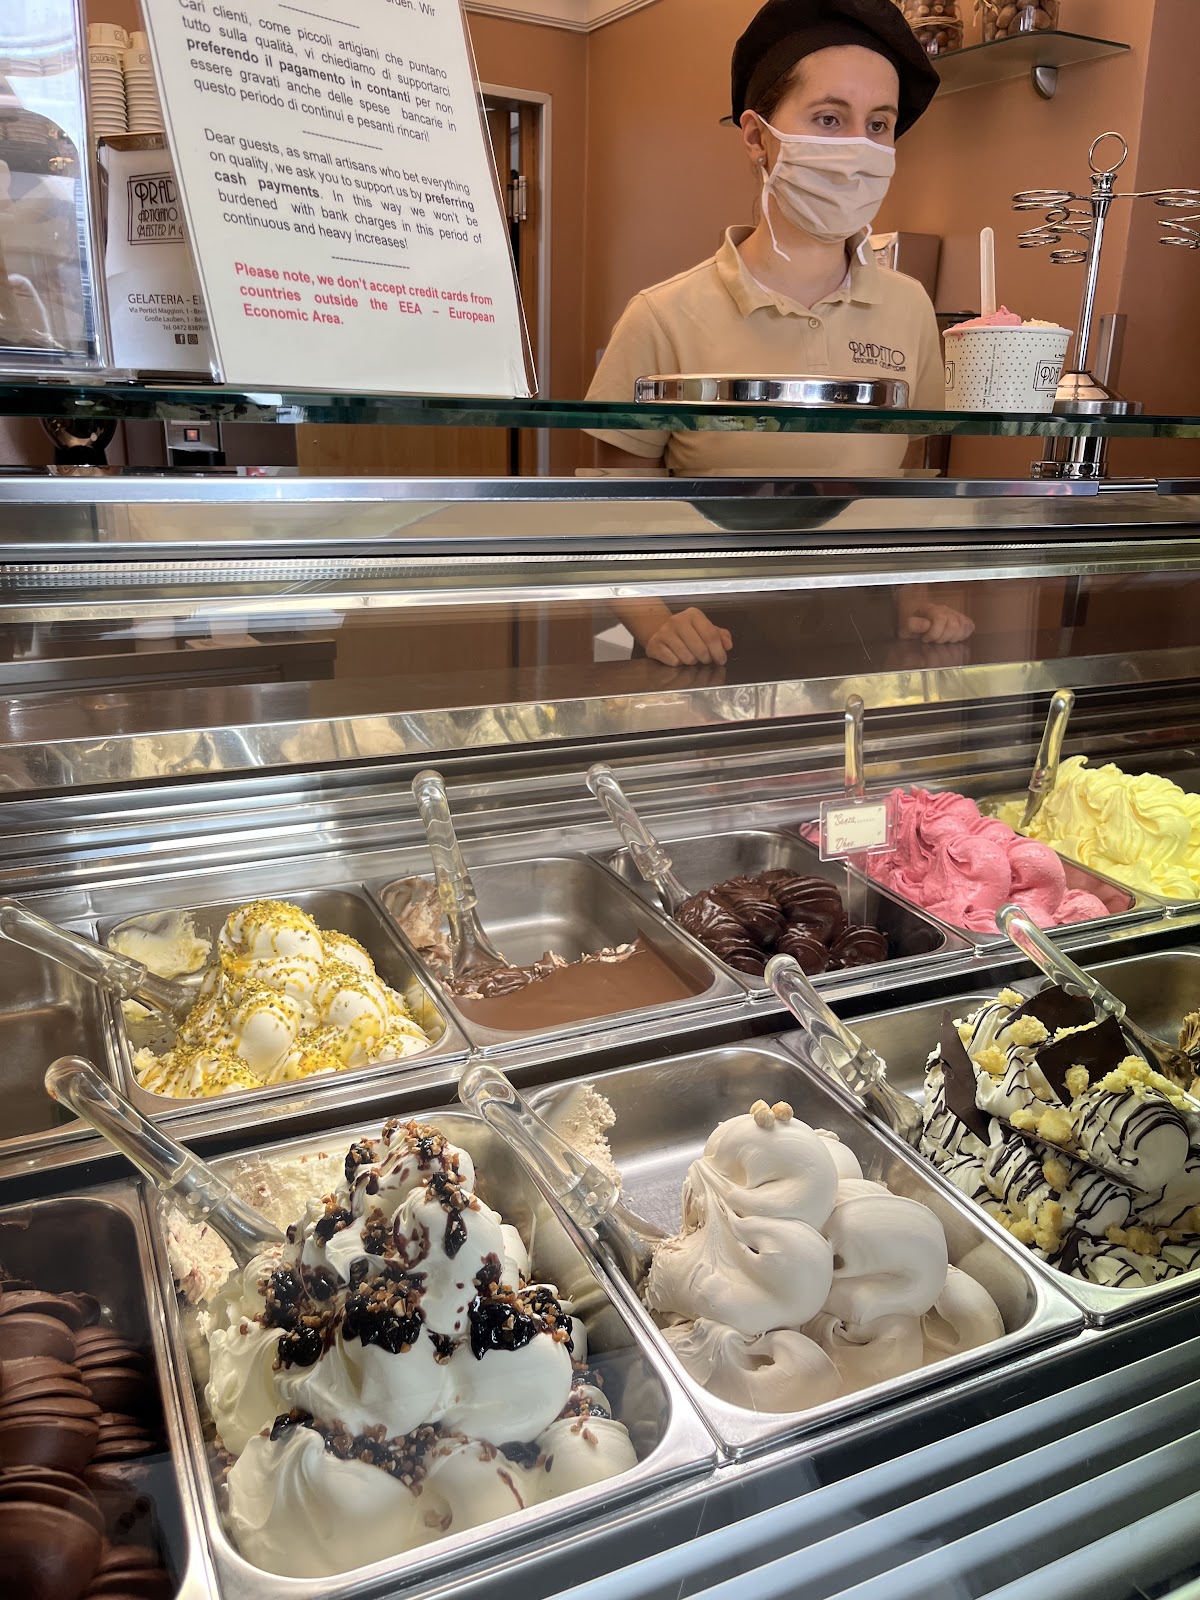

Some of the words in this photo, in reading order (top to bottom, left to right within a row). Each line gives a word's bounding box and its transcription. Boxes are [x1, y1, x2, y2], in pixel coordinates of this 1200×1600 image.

[418, 2, 436, 17] Wir
[179, 0, 206, 13] Cari
[213, 5, 252, 27] clienti,
[259, 19, 291, 35] come
[297, 28, 333, 46] piccoli
[338, 40, 380, 60] artigiani
[385, 52, 404, 66] che
[409, 60, 448, 79] puntano
[182, 16, 211, 33] tutto
[219, 26, 247, 42] sulla
[255, 36, 298, 57] qualità,
[304, 48, 315, 60] vi
[321, 52, 376, 76] chiediamo
[382, 68, 392, 80] di
[397, 73, 451, 97] supportarci
[187, 38, 259, 63] preferendo
[264, 54, 273, 67] il
[279, 60, 346, 85] pagamento
[351, 75, 362, 90] in
[367, 82, 411, 103] contanti
[415, 96, 431, 109] per
[435, 101, 454, 115] non
[190, 58, 233, 77] essere
[240, 70, 280, 89] gravati
[286, 80, 322, 98] anche
[327, 90, 354, 106] delle
[359, 99, 391, 115] spese
[401, 108, 443, 129] bancarie
[448, 119, 457, 132] in
[193, 79, 236, 97] questo
[239, 89, 285, 108] periodo
[287, 99, 298, 111] di
[301, 103, 345, 122] continui
[347, 113, 355, 124] e
[357, 116, 395, 134] pesanti
[397, 125, 430, 142] rincari!
[204, 127, 236, 145] Dear
[239, 137, 283, 157] guests,
[286, 147, 301, 158] as
[303, 150, 333, 165] small
[335, 157, 377, 175] artisans
[379, 166, 401, 179] who
[402, 169, 420, 184] bet
[421, 175, 471, 196] everything
[209, 151, 226, 163] on
[229, 154, 273, 174] quality,
[275, 163, 293, 175] we
[296, 167, 317, 180] ask
[318, 171, 339, 185] you
[341, 174, 352, 187] to
[354, 179, 395, 195] support
[396, 187, 409, 198] us
[410, 188, 423, 203] by
[425, 192, 475, 213] preferring
[135, 179, 177, 209] PRAD
[214, 171, 247, 186] cash
[258, 178, 324, 199] payments.
[333, 190, 344, 203] In
[353, 194, 373, 208] this
[381, 200, 402, 216] way
[410, 206, 426, 218] we
[433, 210, 460, 224] won't
[466, 215, 479, 227] be
[218, 188, 278, 210] burdened
[291, 202, 315, 216] with
[320, 205, 349, 222] bank
[354, 212, 397, 230] charges
[402, 220, 412, 233] in
[416, 222, 434, 236] this
[439, 228, 469, 242] period
[473, 233, 482, 244] of
[137, 223, 166, 239] MEISTER
[223, 211, 291, 232] continuous
[293, 222, 316, 235] and
[318, 224, 352, 244] heavy
[354, 229, 409, 250] increases!
[127, 293, 185, 305] GELATERIA
[234, 261, 280, 280] Please
[283, 270, 315, 286] note,
[317, 275, 335, 286] we
[337, 275, 368, 291] don't
[370, 281, 406, 297] accept
[408, 286, 440, 299] credit
[441, 290, 469, 303] cards
[470, 292, 493, 306] from
[239, 285, 302, 302] countries
[314, 293, 359, 308] outside
[370, 298, 388, 311] the
[399, 300, 423, 315] EEA
[449, 306, 495, 324] European
[243, 303, 309, 322] Economic
[312, 309, 344, 325] Area.
